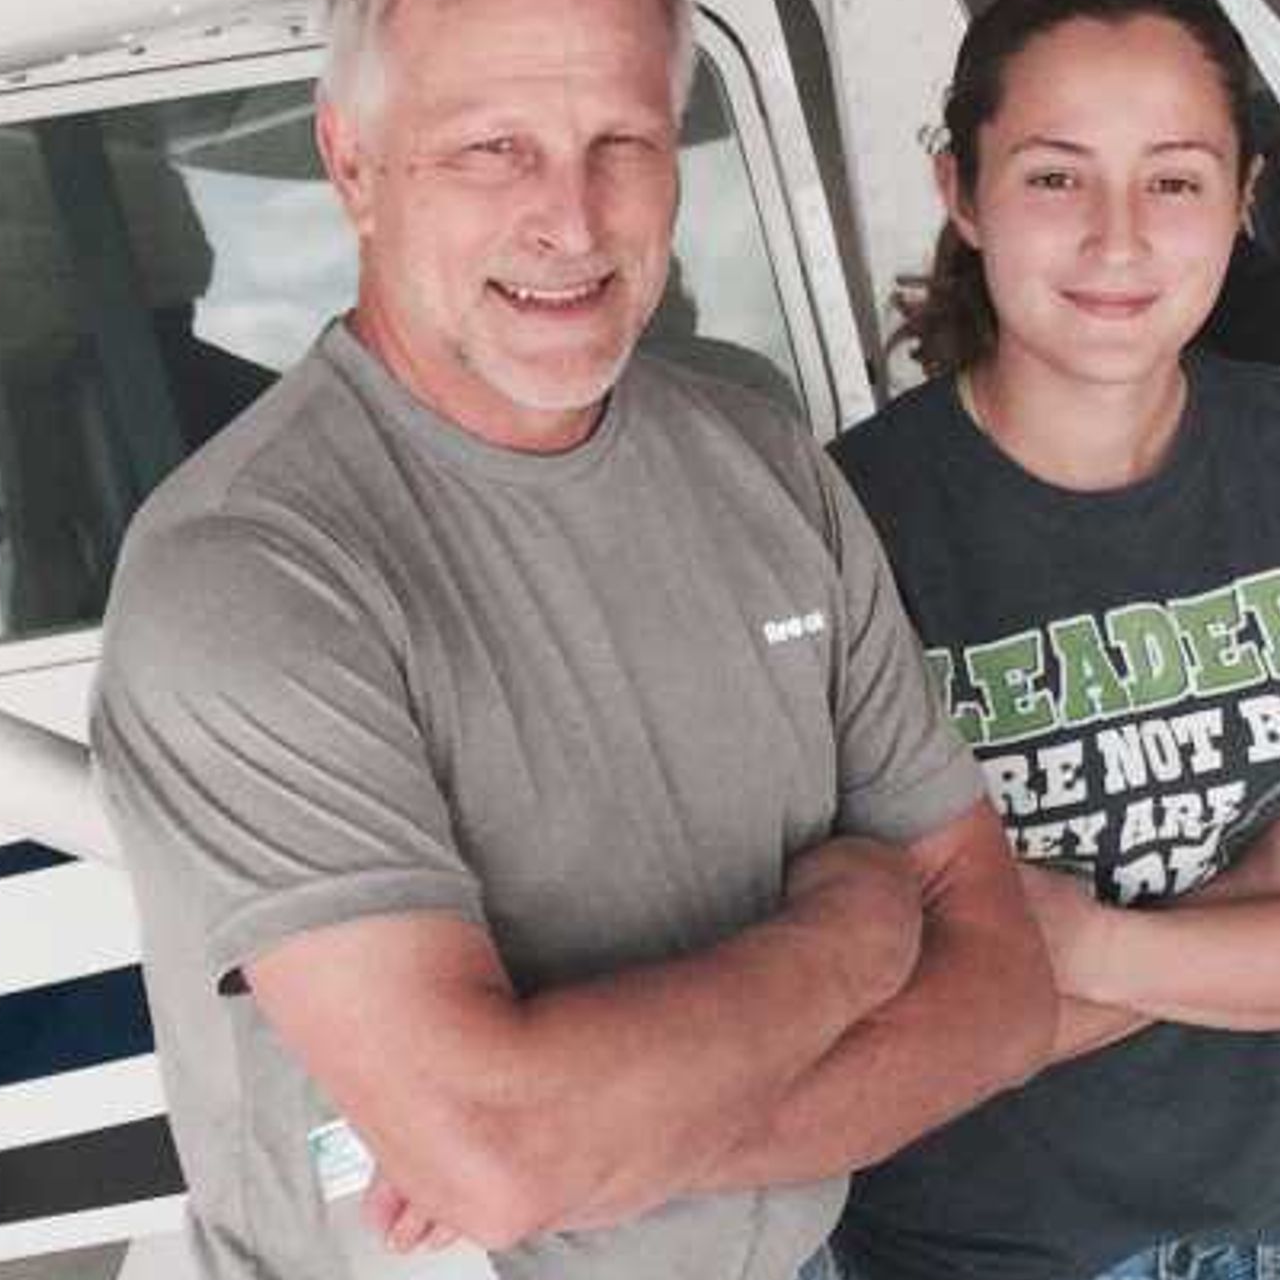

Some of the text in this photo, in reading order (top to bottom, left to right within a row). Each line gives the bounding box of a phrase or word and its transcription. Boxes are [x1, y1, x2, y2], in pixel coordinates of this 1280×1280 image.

[982, 739, 1088, 815] RE
[1097, 707, 1224, 794] NOT
[1120, 781, 1247, 854] ARE
